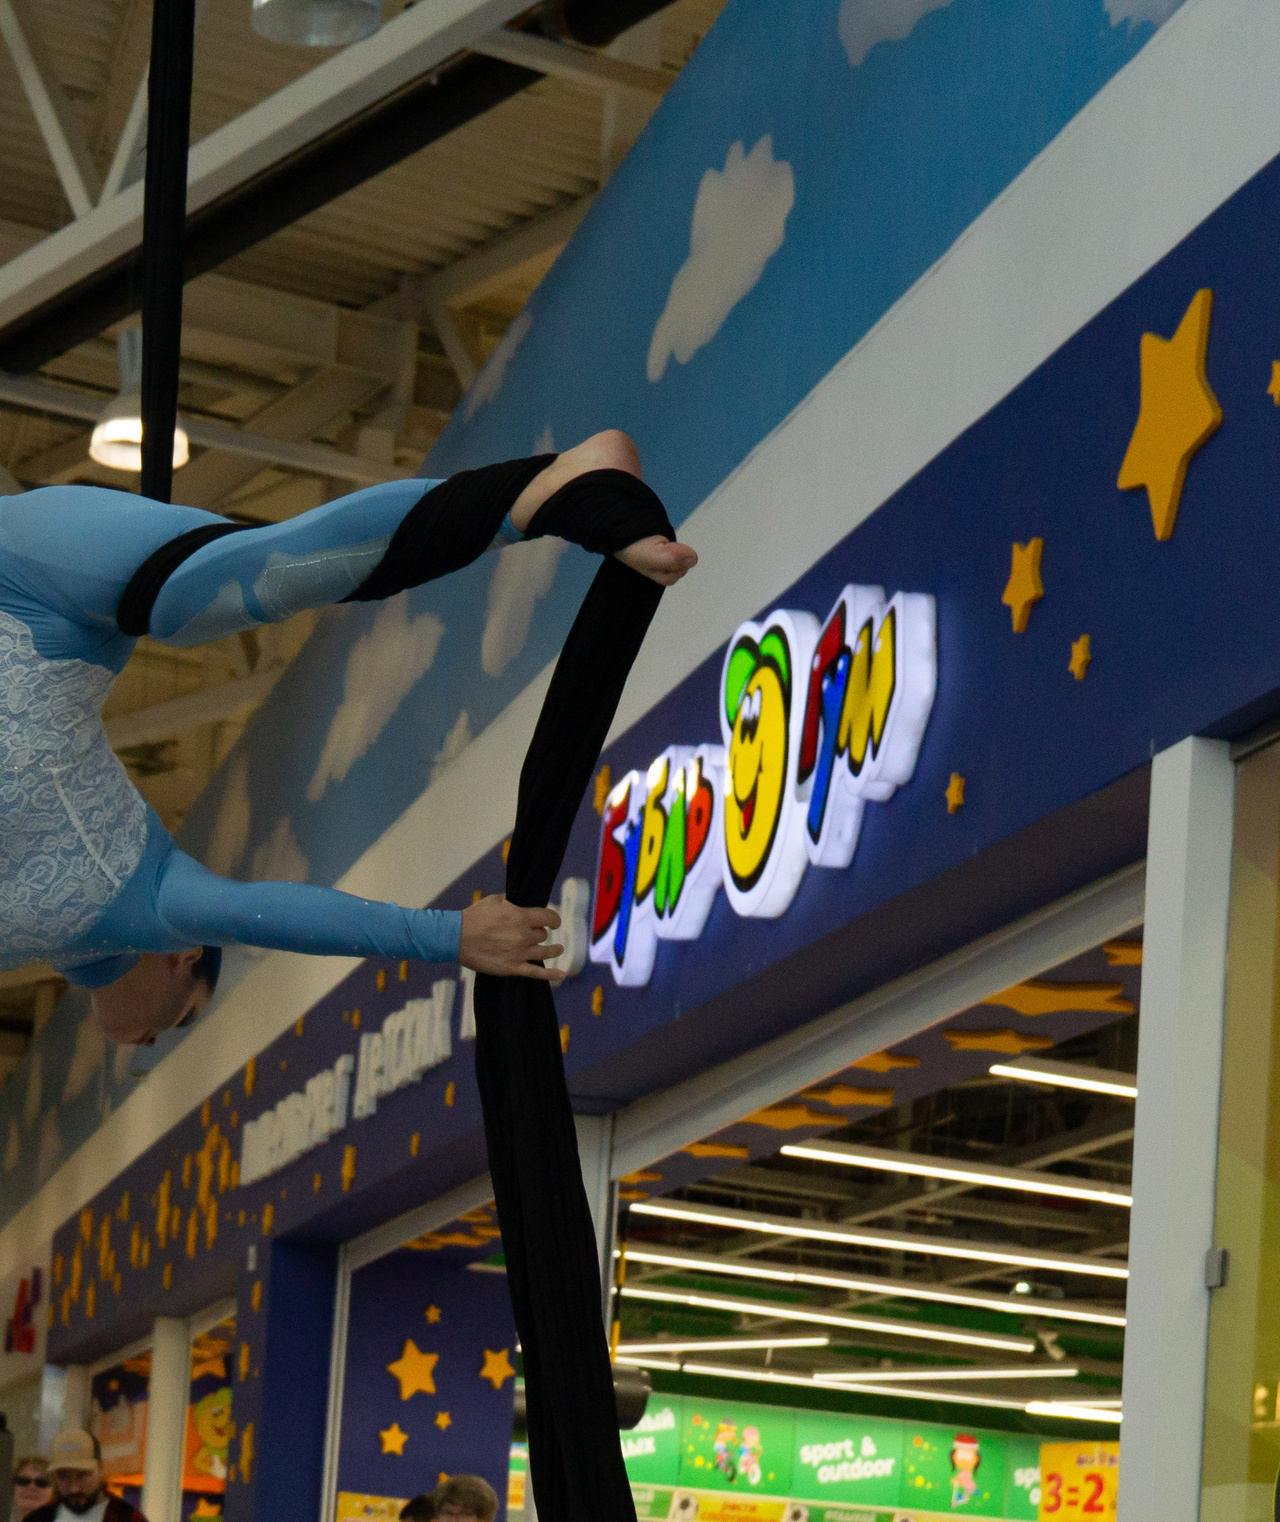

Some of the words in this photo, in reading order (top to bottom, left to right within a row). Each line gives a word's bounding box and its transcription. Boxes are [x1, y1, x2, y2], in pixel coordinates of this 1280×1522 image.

[796, 599, 898, 846] ГУМ
[799, 1438, 855, 1468] sport
[817, 1457, 896, 1484] outdoor
[1044, 1472, 1105, 1513] 3=2
